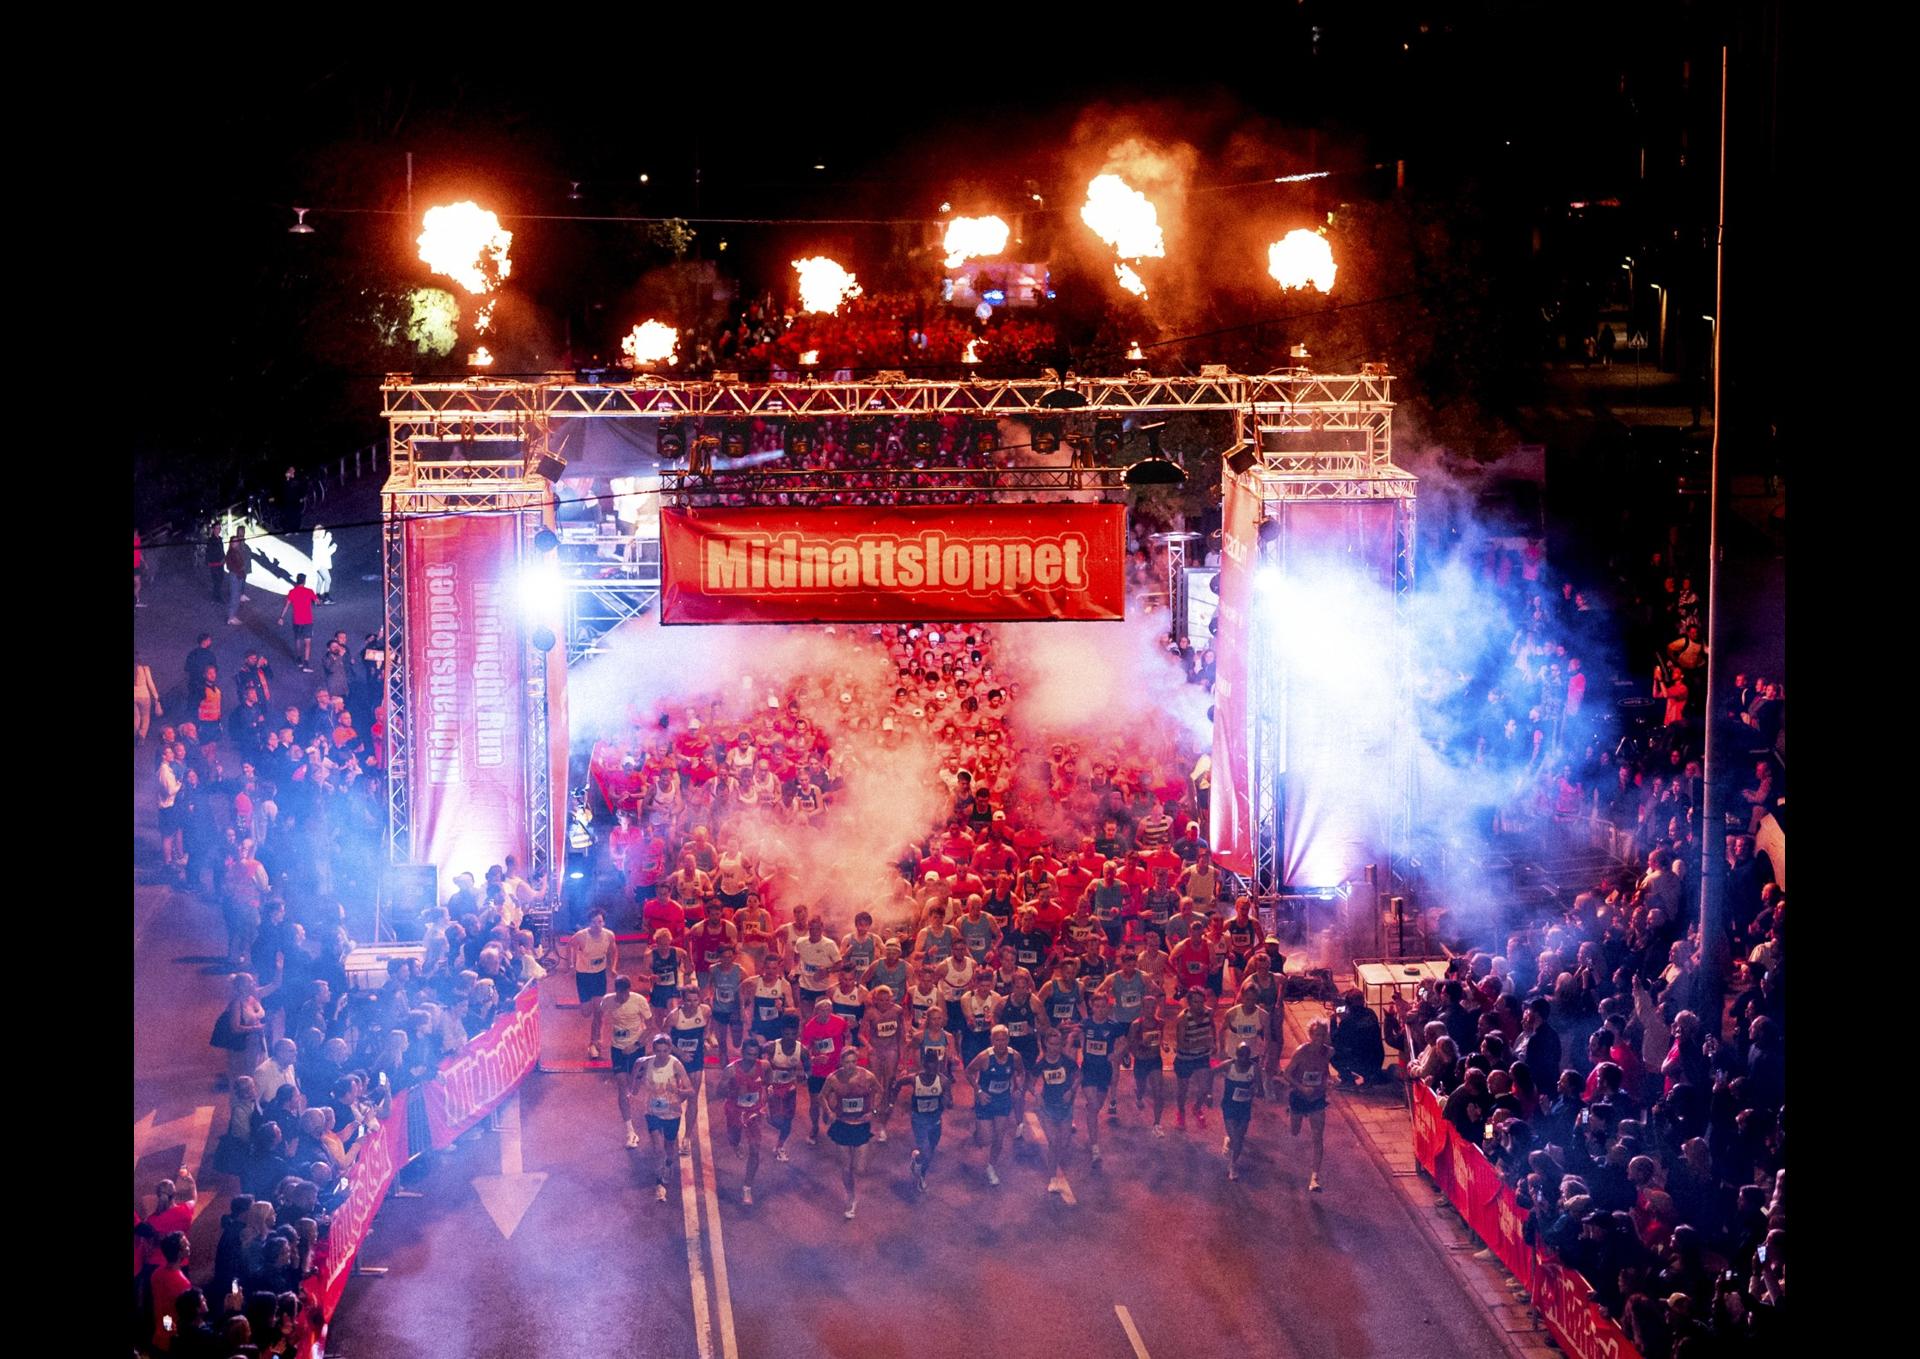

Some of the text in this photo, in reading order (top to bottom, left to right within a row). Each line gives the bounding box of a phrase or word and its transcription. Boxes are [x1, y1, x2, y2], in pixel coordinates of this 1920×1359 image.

[708, 537, 1082, 591] Midnattsloppet
[426, 564, 460, 784] Midnattsloppet
[472, 583, 506, 765] Midnight Run
